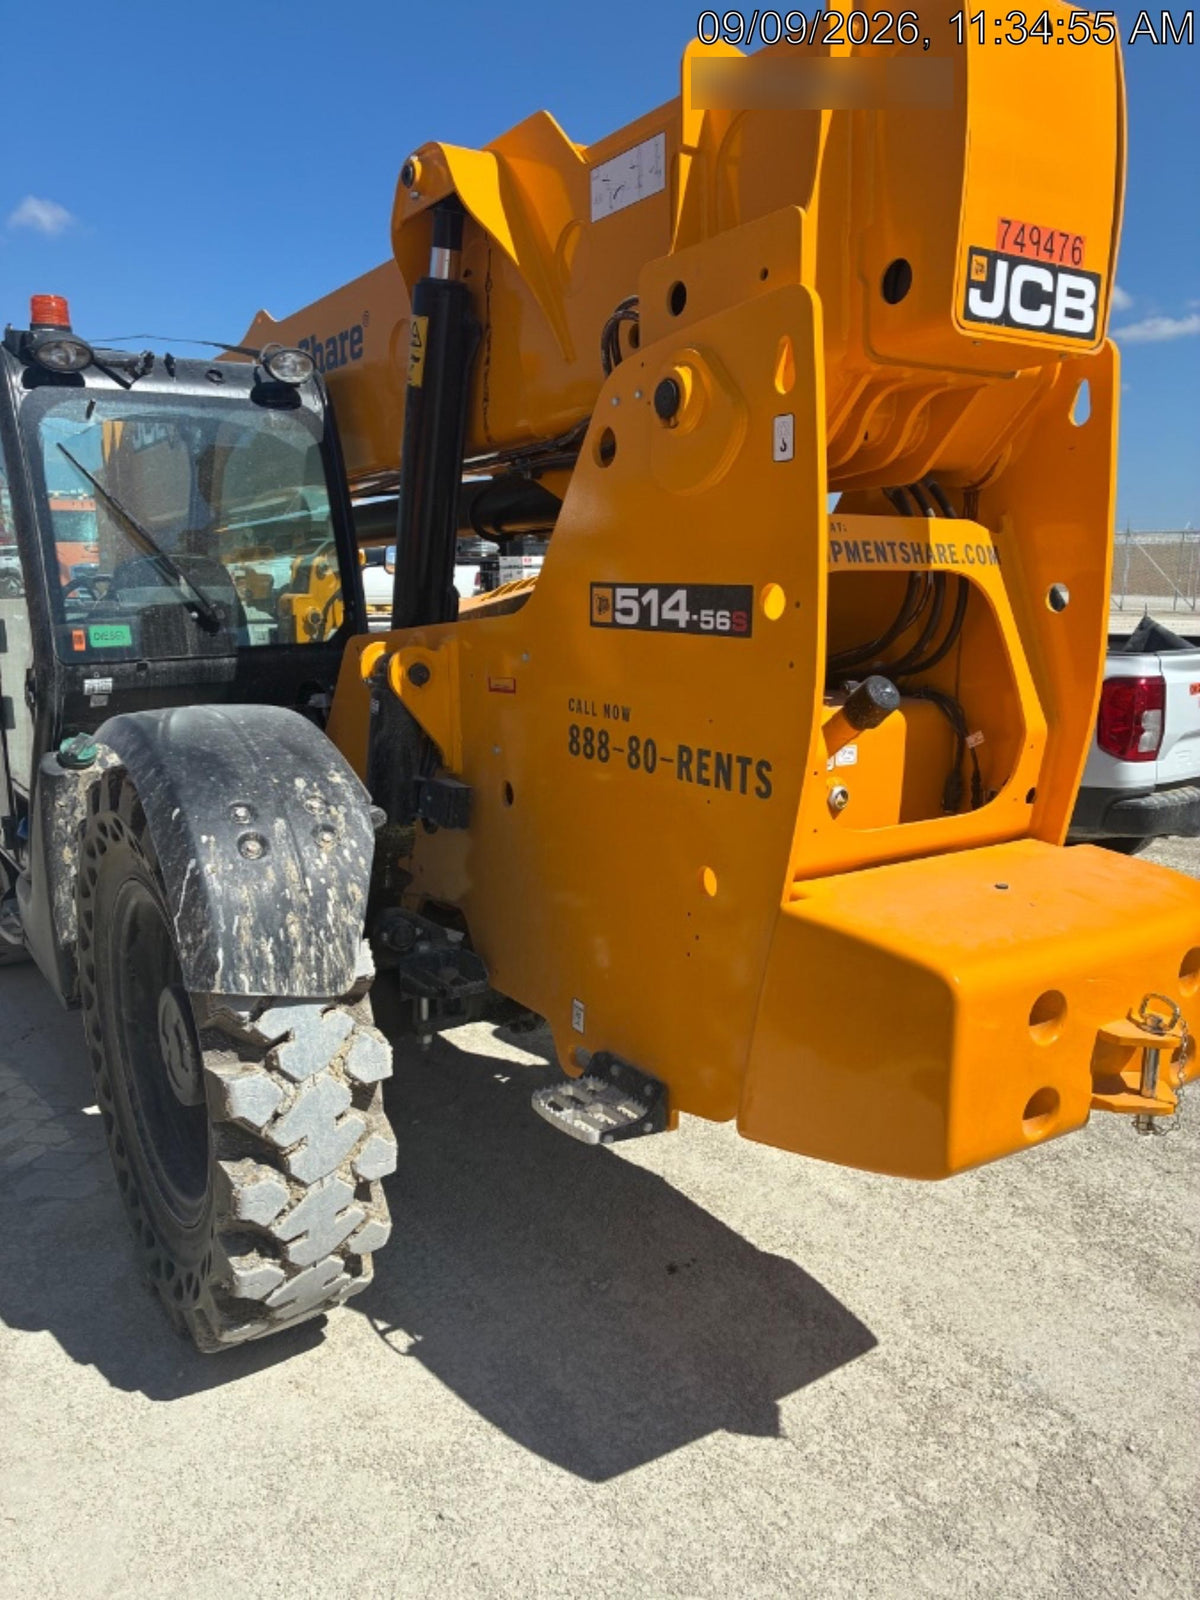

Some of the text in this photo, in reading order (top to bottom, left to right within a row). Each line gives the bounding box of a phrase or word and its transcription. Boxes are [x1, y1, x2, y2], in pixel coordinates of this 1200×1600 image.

[1000, 219, 1083, 266] 749476
[968, 259, 1096, 333] JCB
[829, 540, 1001, 566] PMENTSHARE.COM
[568, 697, 631, 722] CALL NOW
[568, 723, 773, 800] 888-80-RENTS
